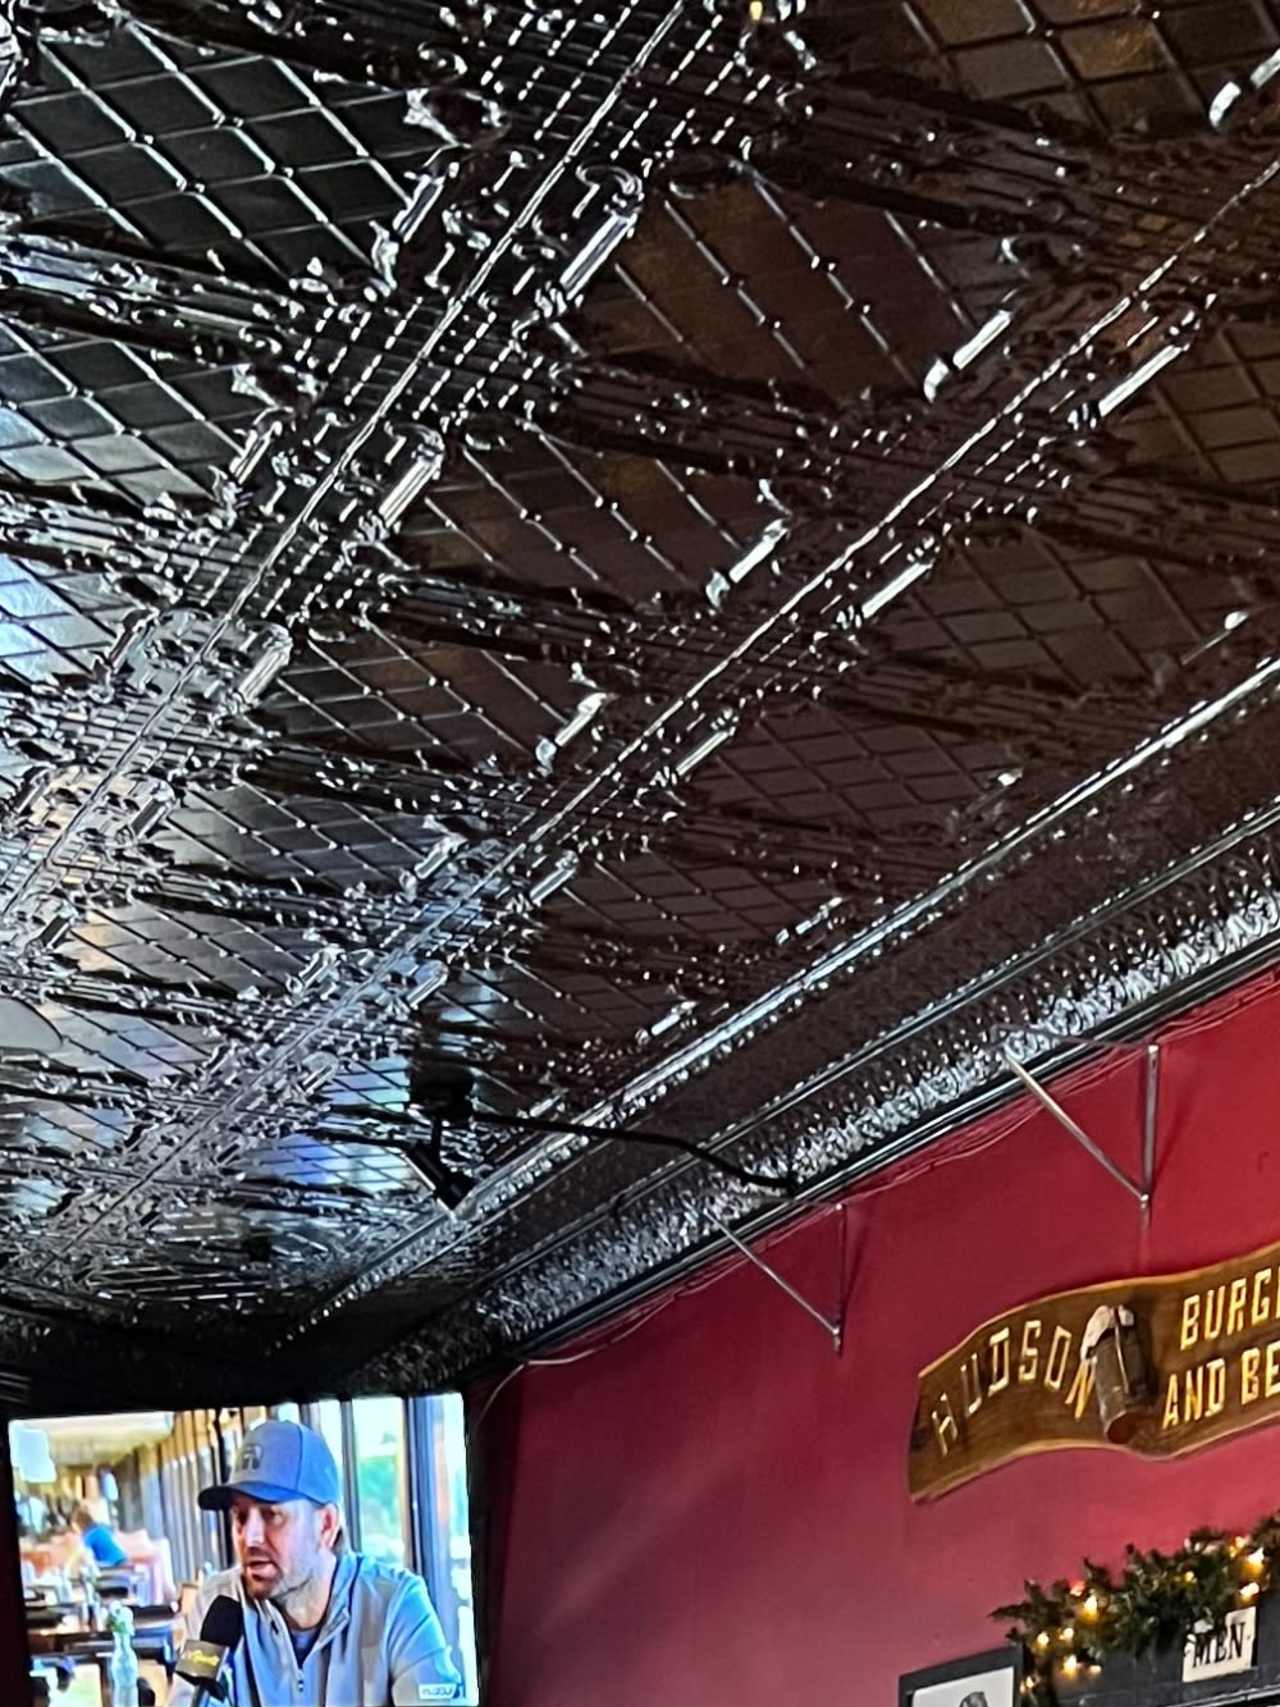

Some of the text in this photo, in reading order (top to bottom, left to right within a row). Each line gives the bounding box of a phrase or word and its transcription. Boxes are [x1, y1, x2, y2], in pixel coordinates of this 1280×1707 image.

[931, 1319, 1098, 1457] HUDSON
[1162, 1357, 1226, 1430] AND
[1191, 1621, 1247, 1668] MEN
